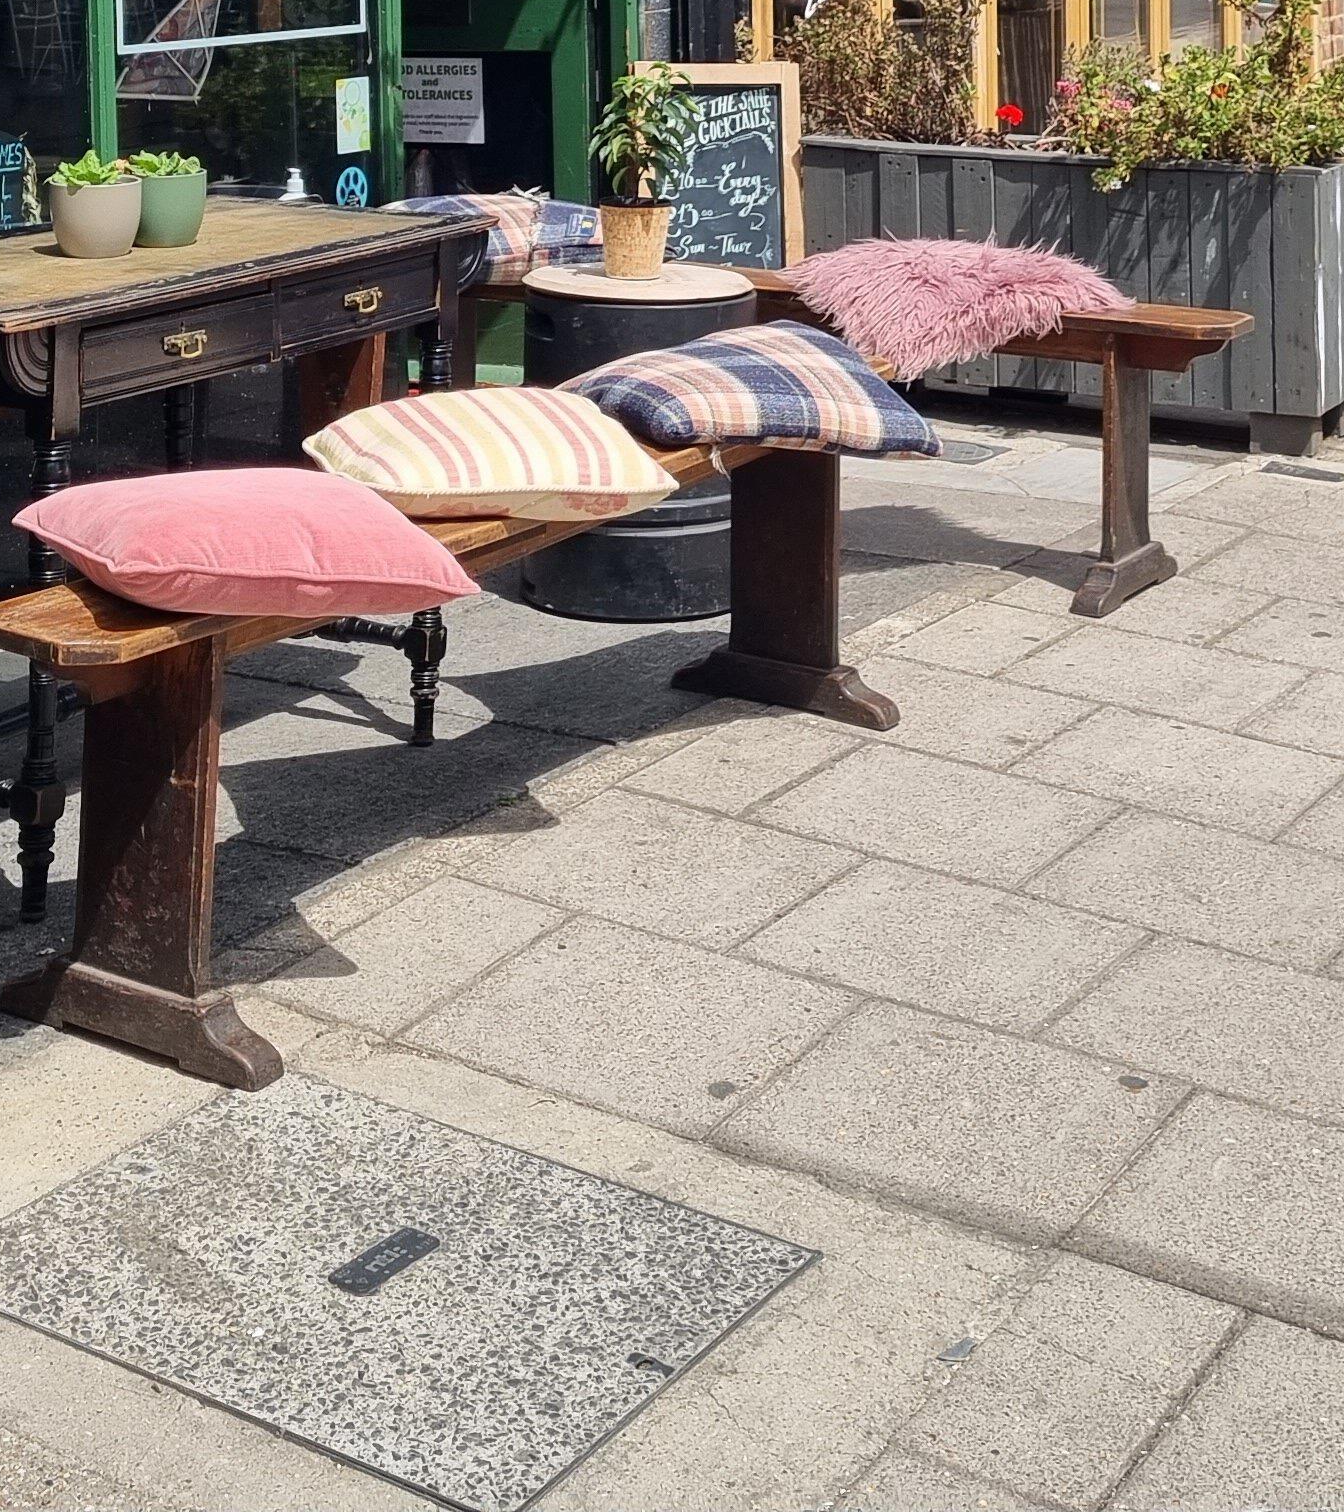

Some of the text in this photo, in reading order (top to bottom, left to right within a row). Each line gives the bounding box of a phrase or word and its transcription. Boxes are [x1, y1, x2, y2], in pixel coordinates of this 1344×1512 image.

[416, 65, 477, 76] ALLERGIES
[421, 78, 439, 86] and
[401, 90, 473, 100] TOLERANCES
[709, 93, 739, 119] THE
